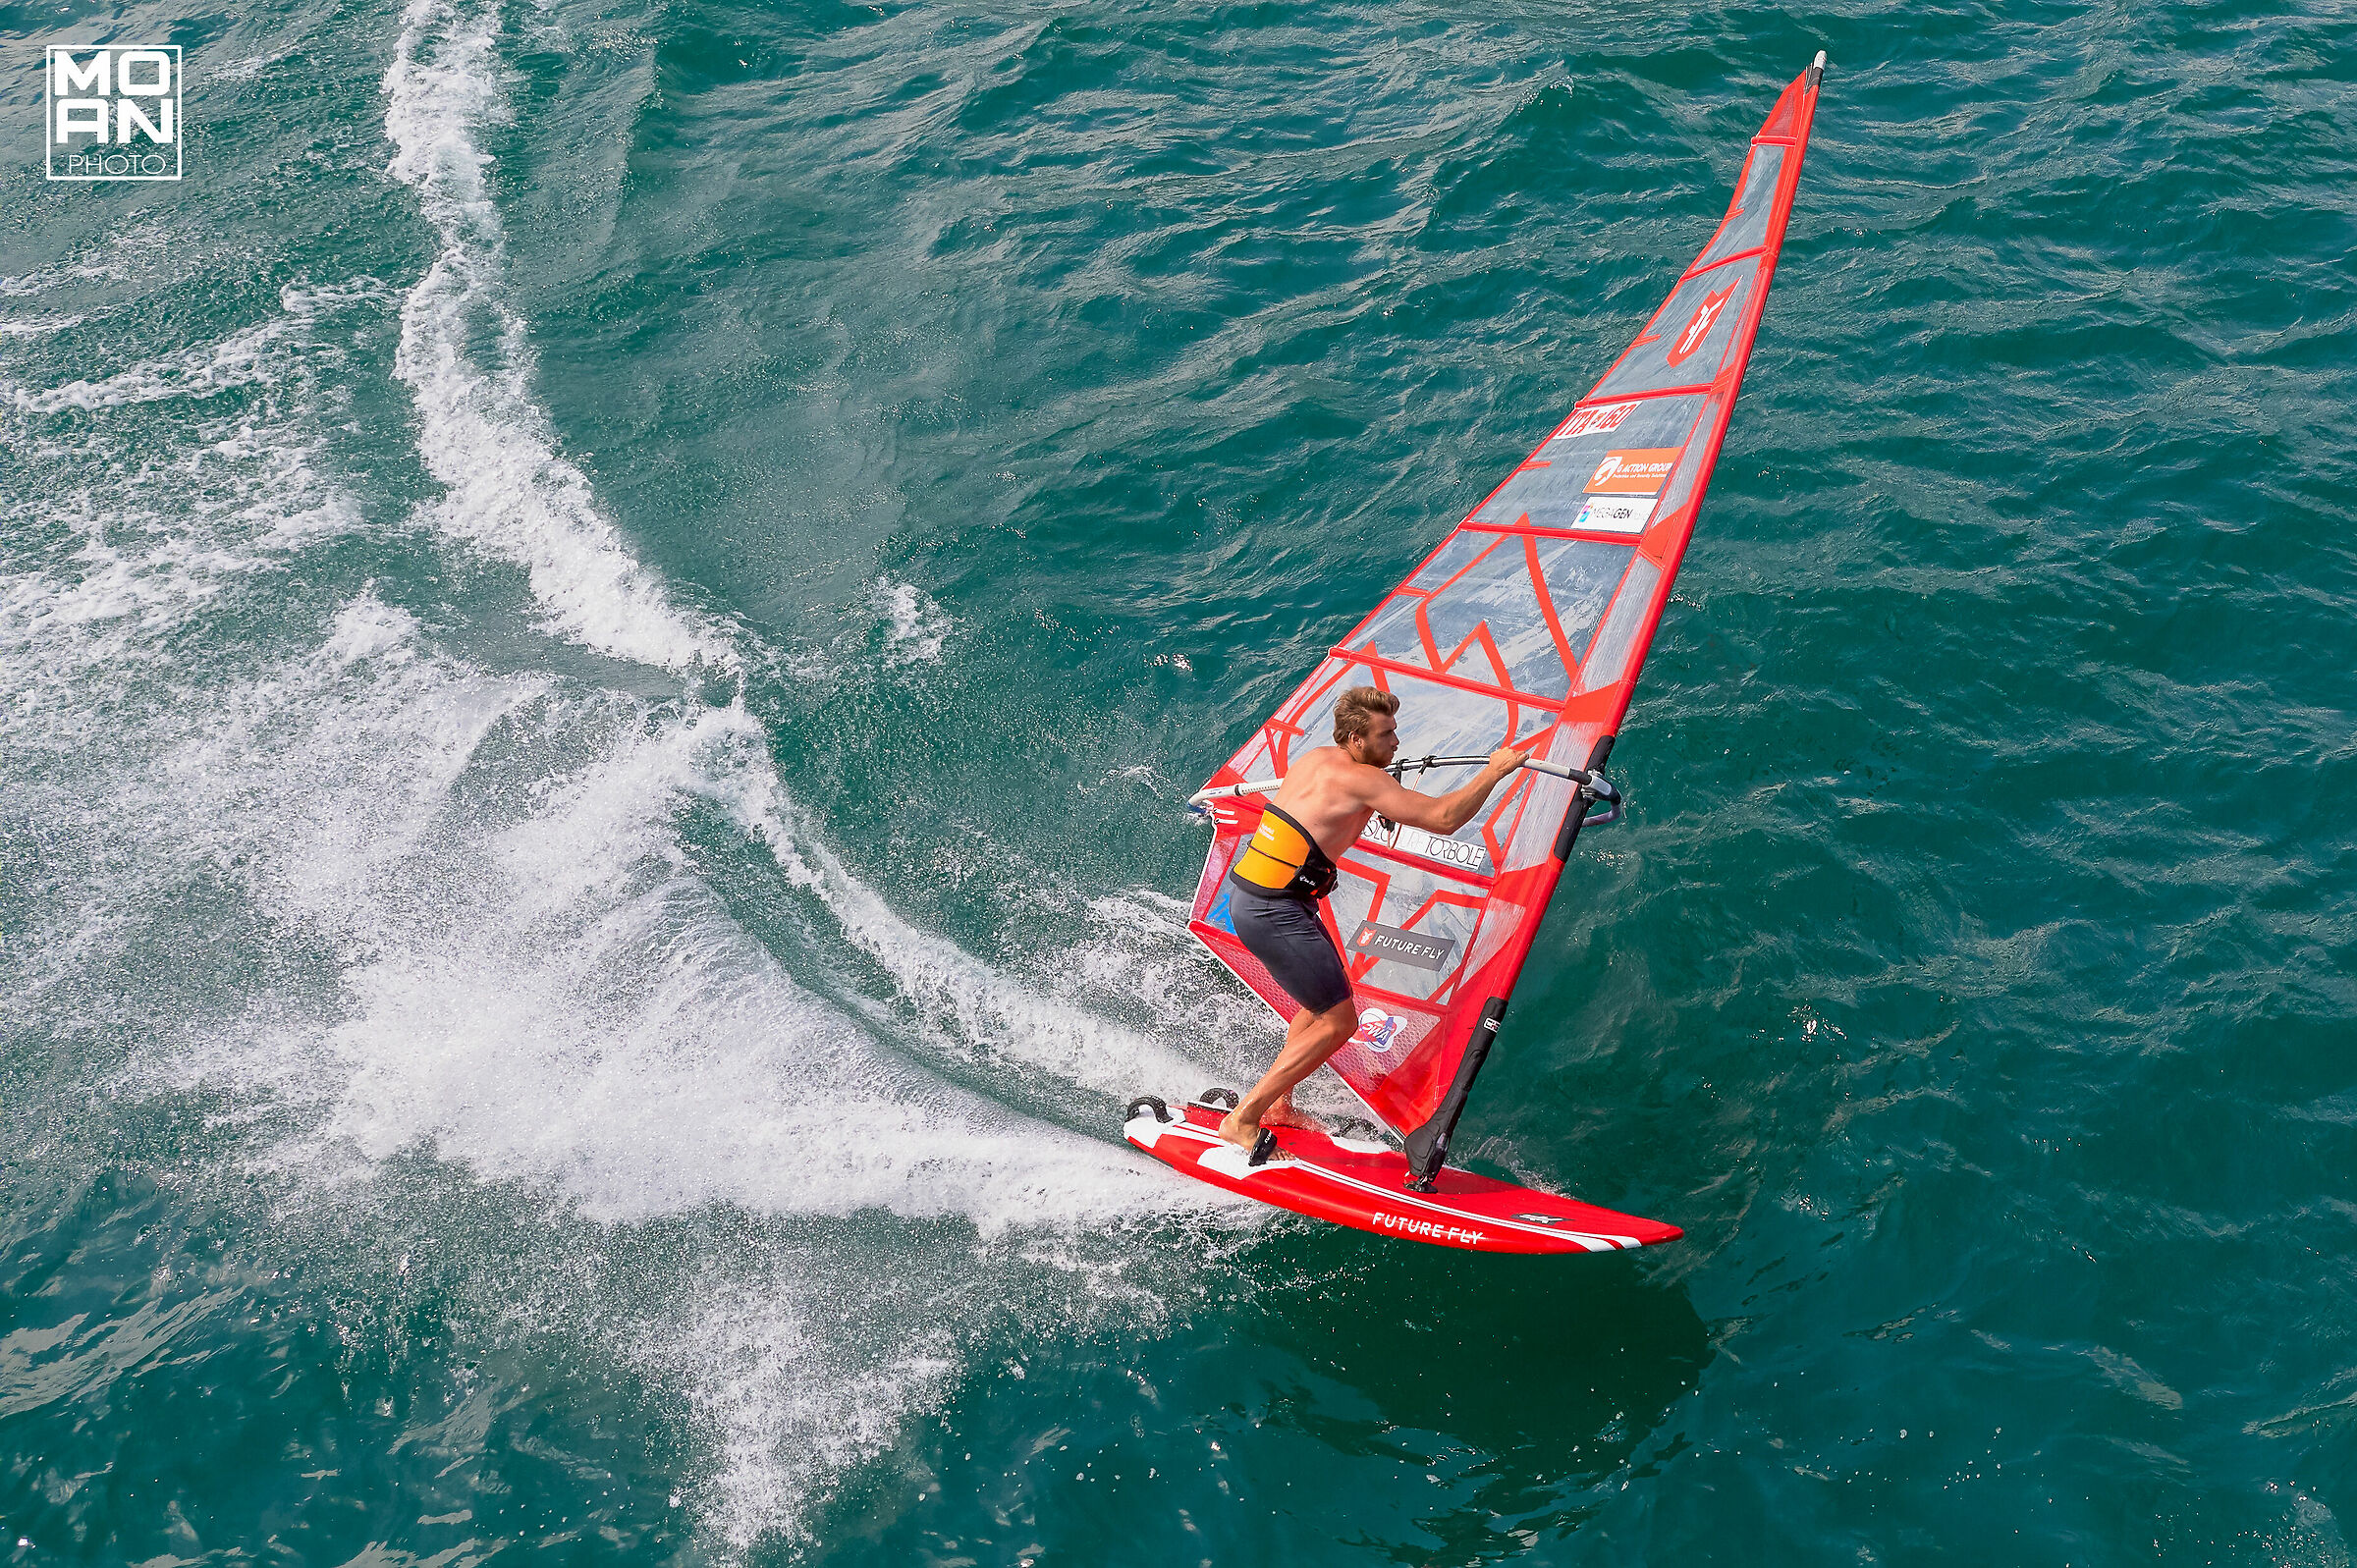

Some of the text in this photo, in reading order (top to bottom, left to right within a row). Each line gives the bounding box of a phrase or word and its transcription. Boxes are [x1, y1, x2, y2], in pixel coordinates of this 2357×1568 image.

[1621, 463, 1649, 472] ACTION
[1425, 836, 1486, 868] TORBOLE
[1375, 935, 1446, 960] FUTURE FLY
[1372, 1212, 1484, 1245] FUTURE FLY
